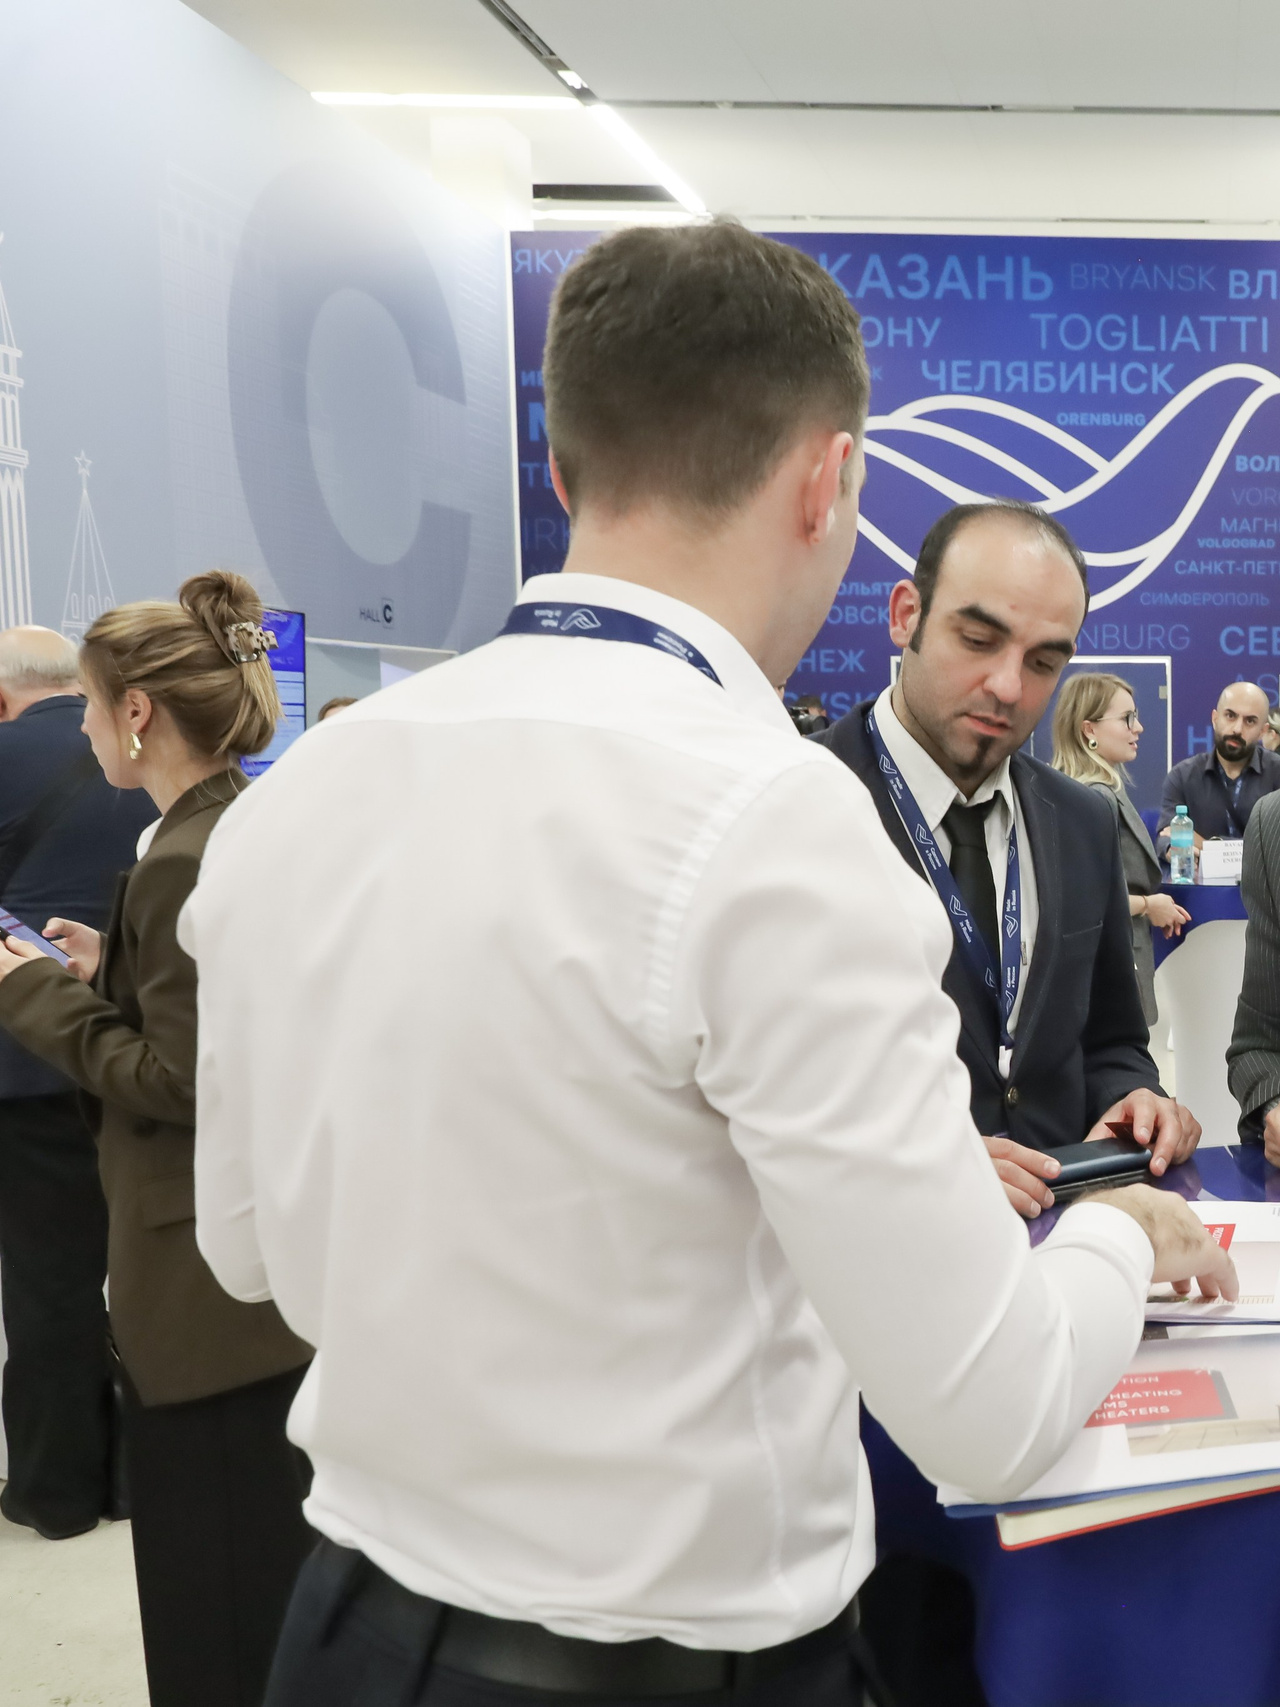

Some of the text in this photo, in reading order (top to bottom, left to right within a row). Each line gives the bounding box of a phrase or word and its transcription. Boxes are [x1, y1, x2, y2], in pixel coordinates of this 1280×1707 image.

[514, 249, 585, 274] ЯКУ
[819, 252, 1054, 301] КАЗАНЬ
[1070, 262, 1216, 292] BRYANSK
[859, 316, 942, 349] ОНУ
[1029, 313, 1269, 353] TOGLIATTI
[921, 359, 1176, 395] ЧЕЛЯБИНСК
[1057, 411, 1147, 428] ORENBURG
[1197, 537, 1275, 549] VOLGOGRAD
[837, 581, 896, 597] ОЛЬЯТ
[1140, 591, 1270, 607] СИМФЕРОПОЛЬ
[359, 604, 393, 623] HALL C
[827, 605, 890, 625] ОВСК
[1077, 623, 1190, 651] NBURG
[797, 649, 866, 673] НЕЖ
[1121, 1376, 1159, 1385] TION
[1109, 1389, 1183, 1400] HEATING
[1094, 1405, 1171, 1420] HEATERS
[1103, 1400, 1128, 1410] MS
